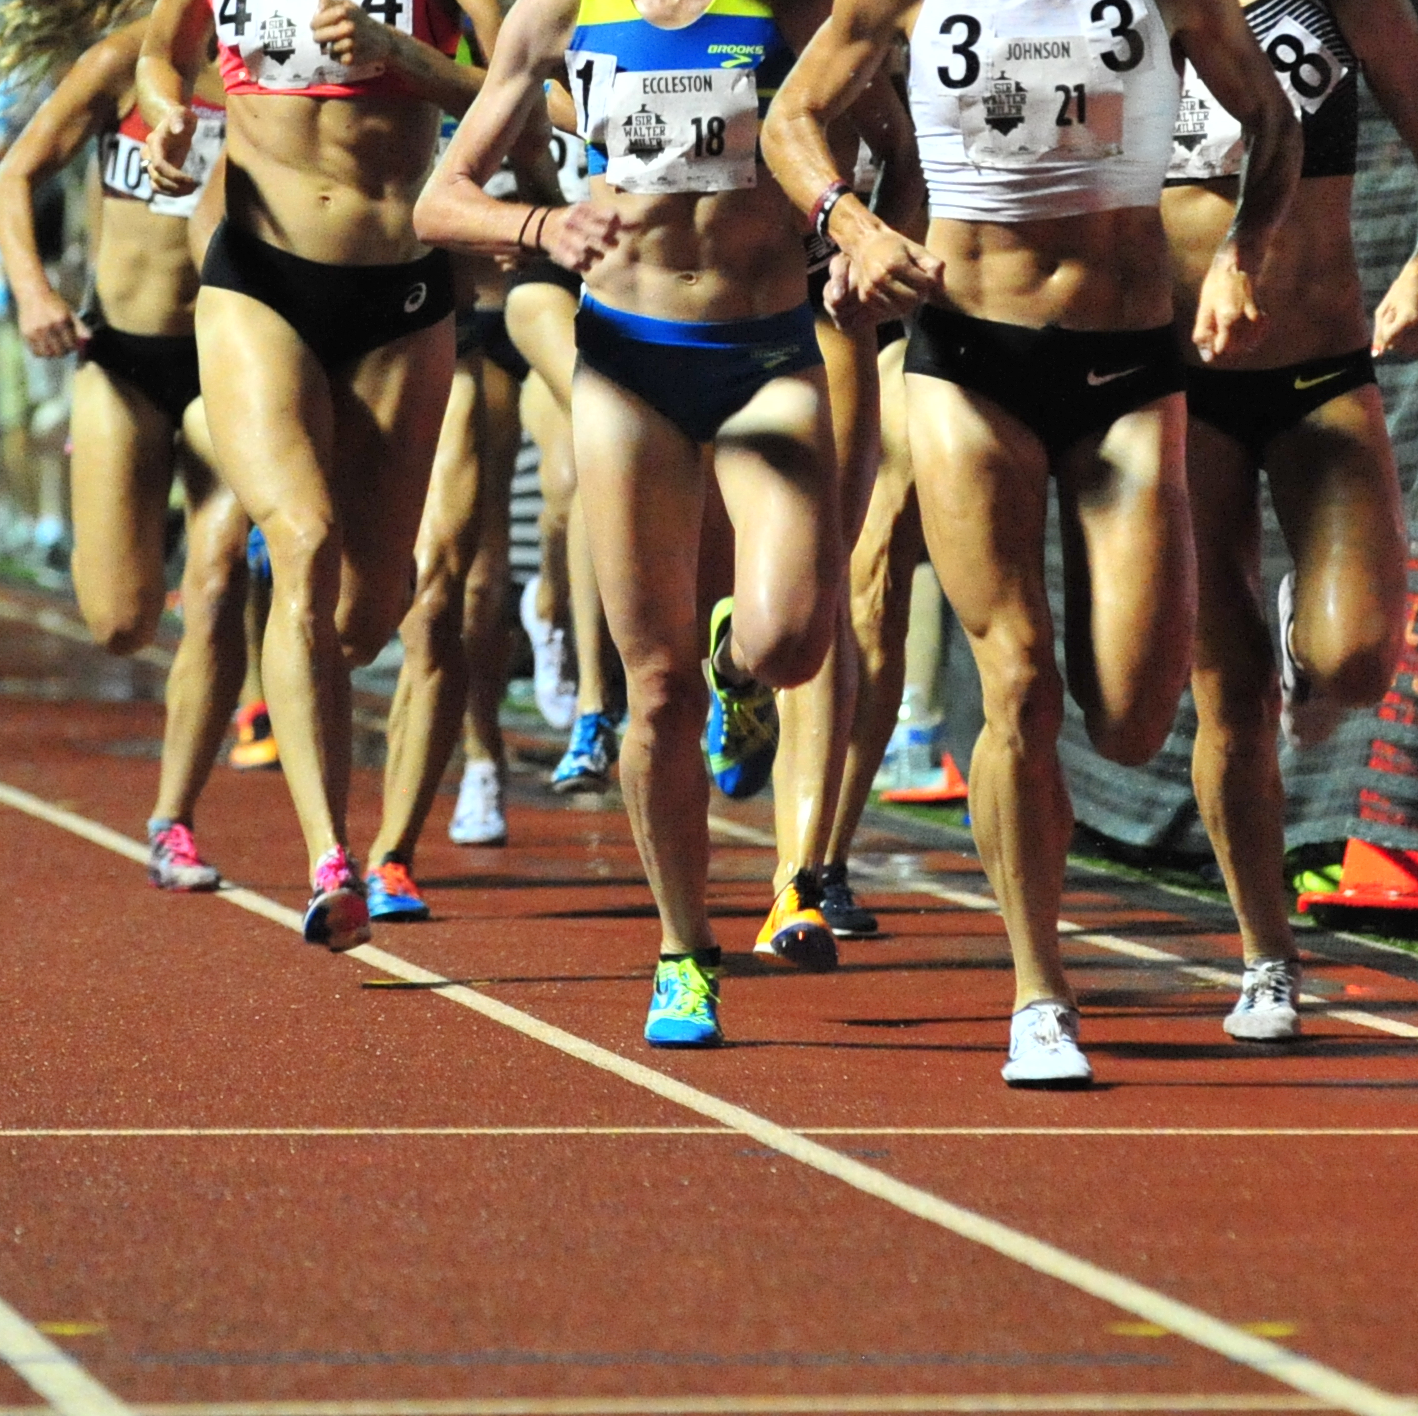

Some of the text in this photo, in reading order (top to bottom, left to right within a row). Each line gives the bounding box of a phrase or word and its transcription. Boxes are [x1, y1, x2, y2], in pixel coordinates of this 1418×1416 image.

[268, 18, 284, 29] SIR
[707, 43, 765, 55] BROOKS
[937, 13, 982, 90] 3
[1005, 41, 1071, 61] JOHNSON
[1266, 33, 1332, 100] 8
[642, 74, 713, 95] ECCLESTON
[993, 82, 1012, 94] SIR
[575, 59, 595, 134] 1
[982, 93, 1027, 105] WALTER
[986, 104, 1023, 117] MILER
[1054, 83, 1086, 127] 21
[634, 114, 653, 126] SIR
[622, 125, 666, 138] WALTER
[690, 115, 727, 158] 18
